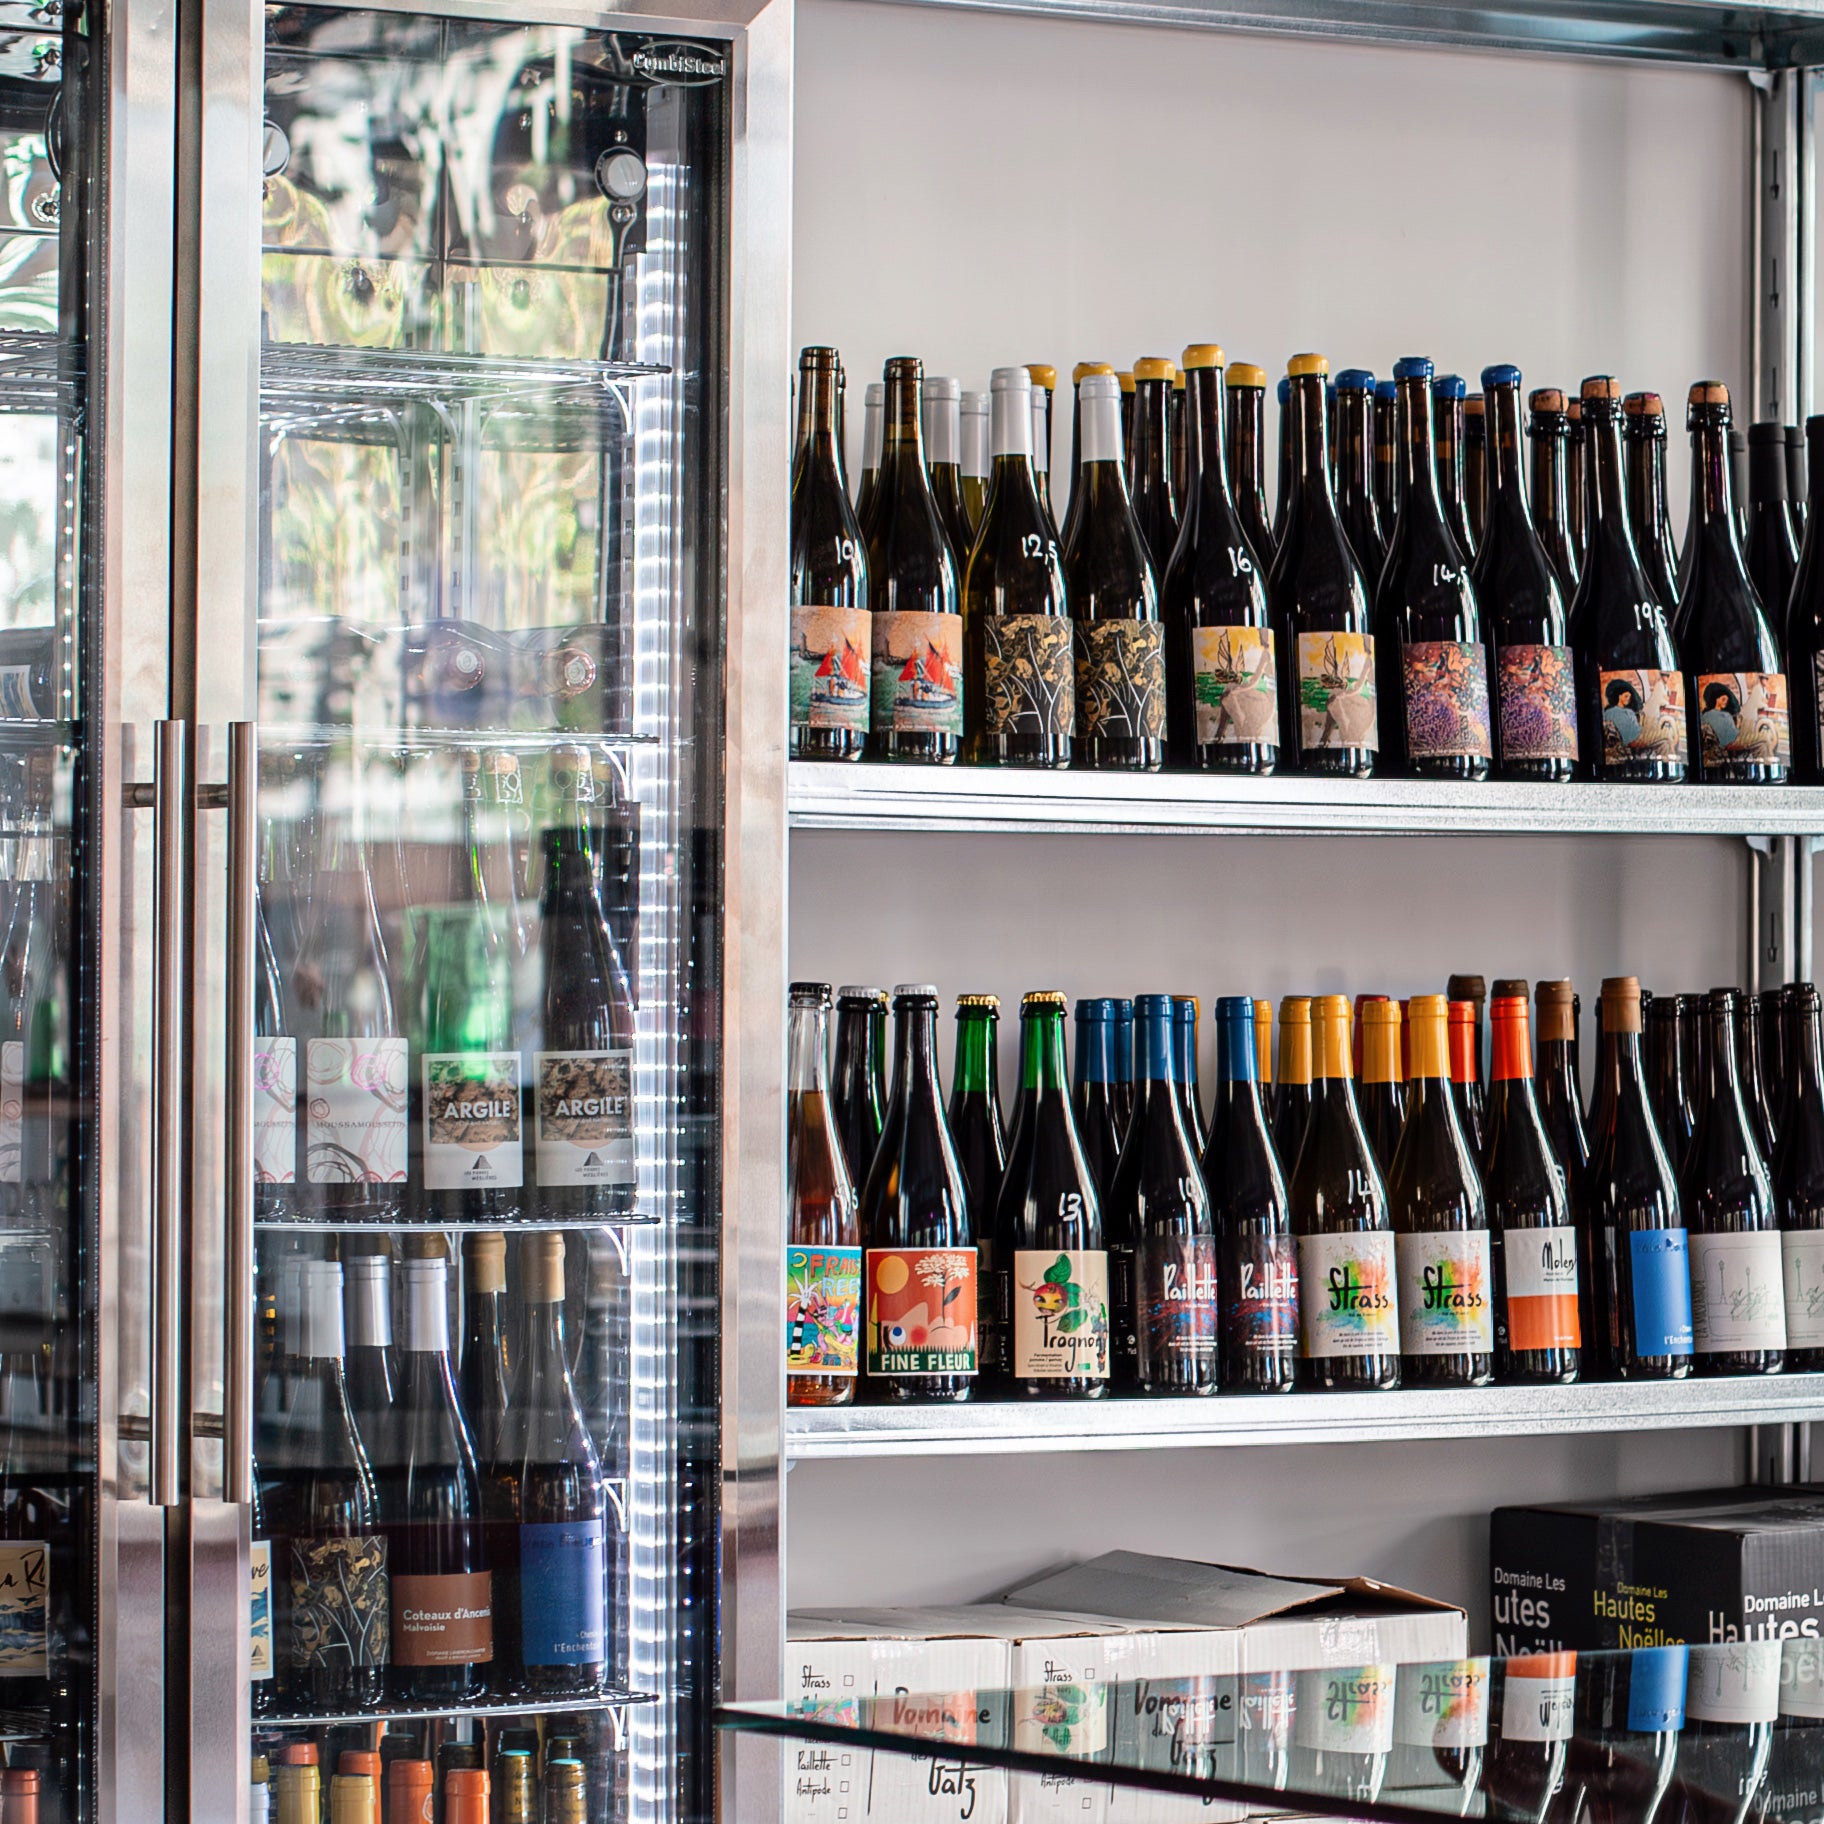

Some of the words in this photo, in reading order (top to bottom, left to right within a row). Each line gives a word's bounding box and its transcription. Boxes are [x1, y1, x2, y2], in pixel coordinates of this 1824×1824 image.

[1228, 547, 1252, 577] 16
[444, 1100, 511, 1119] ARGILE
[555, 1097, 624, 1117] ARGILE
[1348, 1169, 1378, 1205] 14
[1058, 1192, 1082, 1222] 13
[810, 1253, 861, 1278] FRAIS
[1163, 1263, 1218, 1302] Paillette
[1240, 1263, 1299, 1301] Paillette
[1328, 1266, 1389, 1311] Strass
[1422, 1266, 1482, 1310] Strass
[881, 1353, 920, 1372] FINE
[927, 1351, 971, 1372] FLEUR
[1494, 1567, 1543, 1590] Domaine
[1545, 1573, 1566, 1592] Les
[1616, 1581, 1652, 1597] Domaine
[1653, 1585, 1668, 1600] Les
[1594, 1590, 1656, 1623] Hautes
[1744, 1591, 1811, 1614] Domaine
[403, 1609, 452, 1622] Coteaux
[403, 1623, 445, 1632] Malvoisie
[802, 1665, 831, 1688] Strass
[1044, 1661, 1073, 1683] Strass
[797, 1751, 838, 1771] Paillette
[796, 1778, 831, 1803] Antipode
